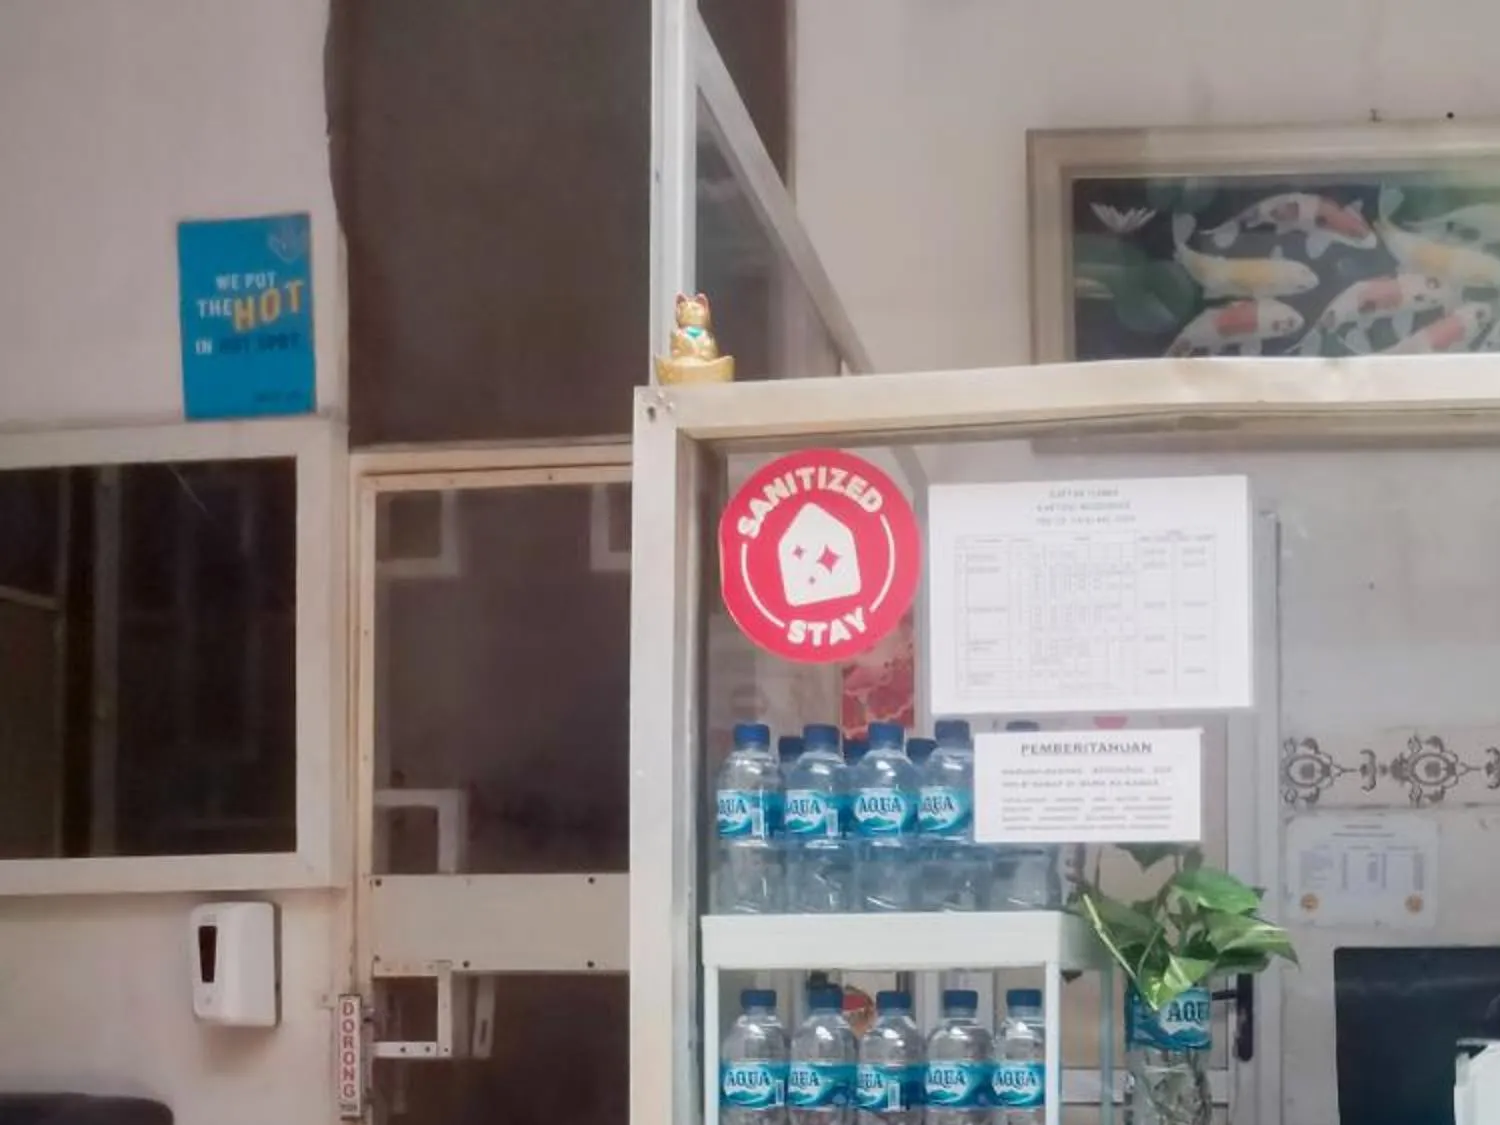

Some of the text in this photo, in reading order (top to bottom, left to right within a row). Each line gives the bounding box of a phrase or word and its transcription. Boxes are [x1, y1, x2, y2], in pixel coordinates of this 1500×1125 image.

[216, 272, 241, 290] WE
[197, 279, 304, 333] THE HOT
[737, 465, 884, 540] SANITIZED
[787, 607, 867, 646] STAY
[1020, 741, 1153, 756] PEMBERITAHUAN
[859, 795, 902, 815] AQUA
[342, 1001, 356, 1098] DORONG
[727, 1070, 771, 1089] AQUA
[994, 1070, 1036, 1089] AQUA
